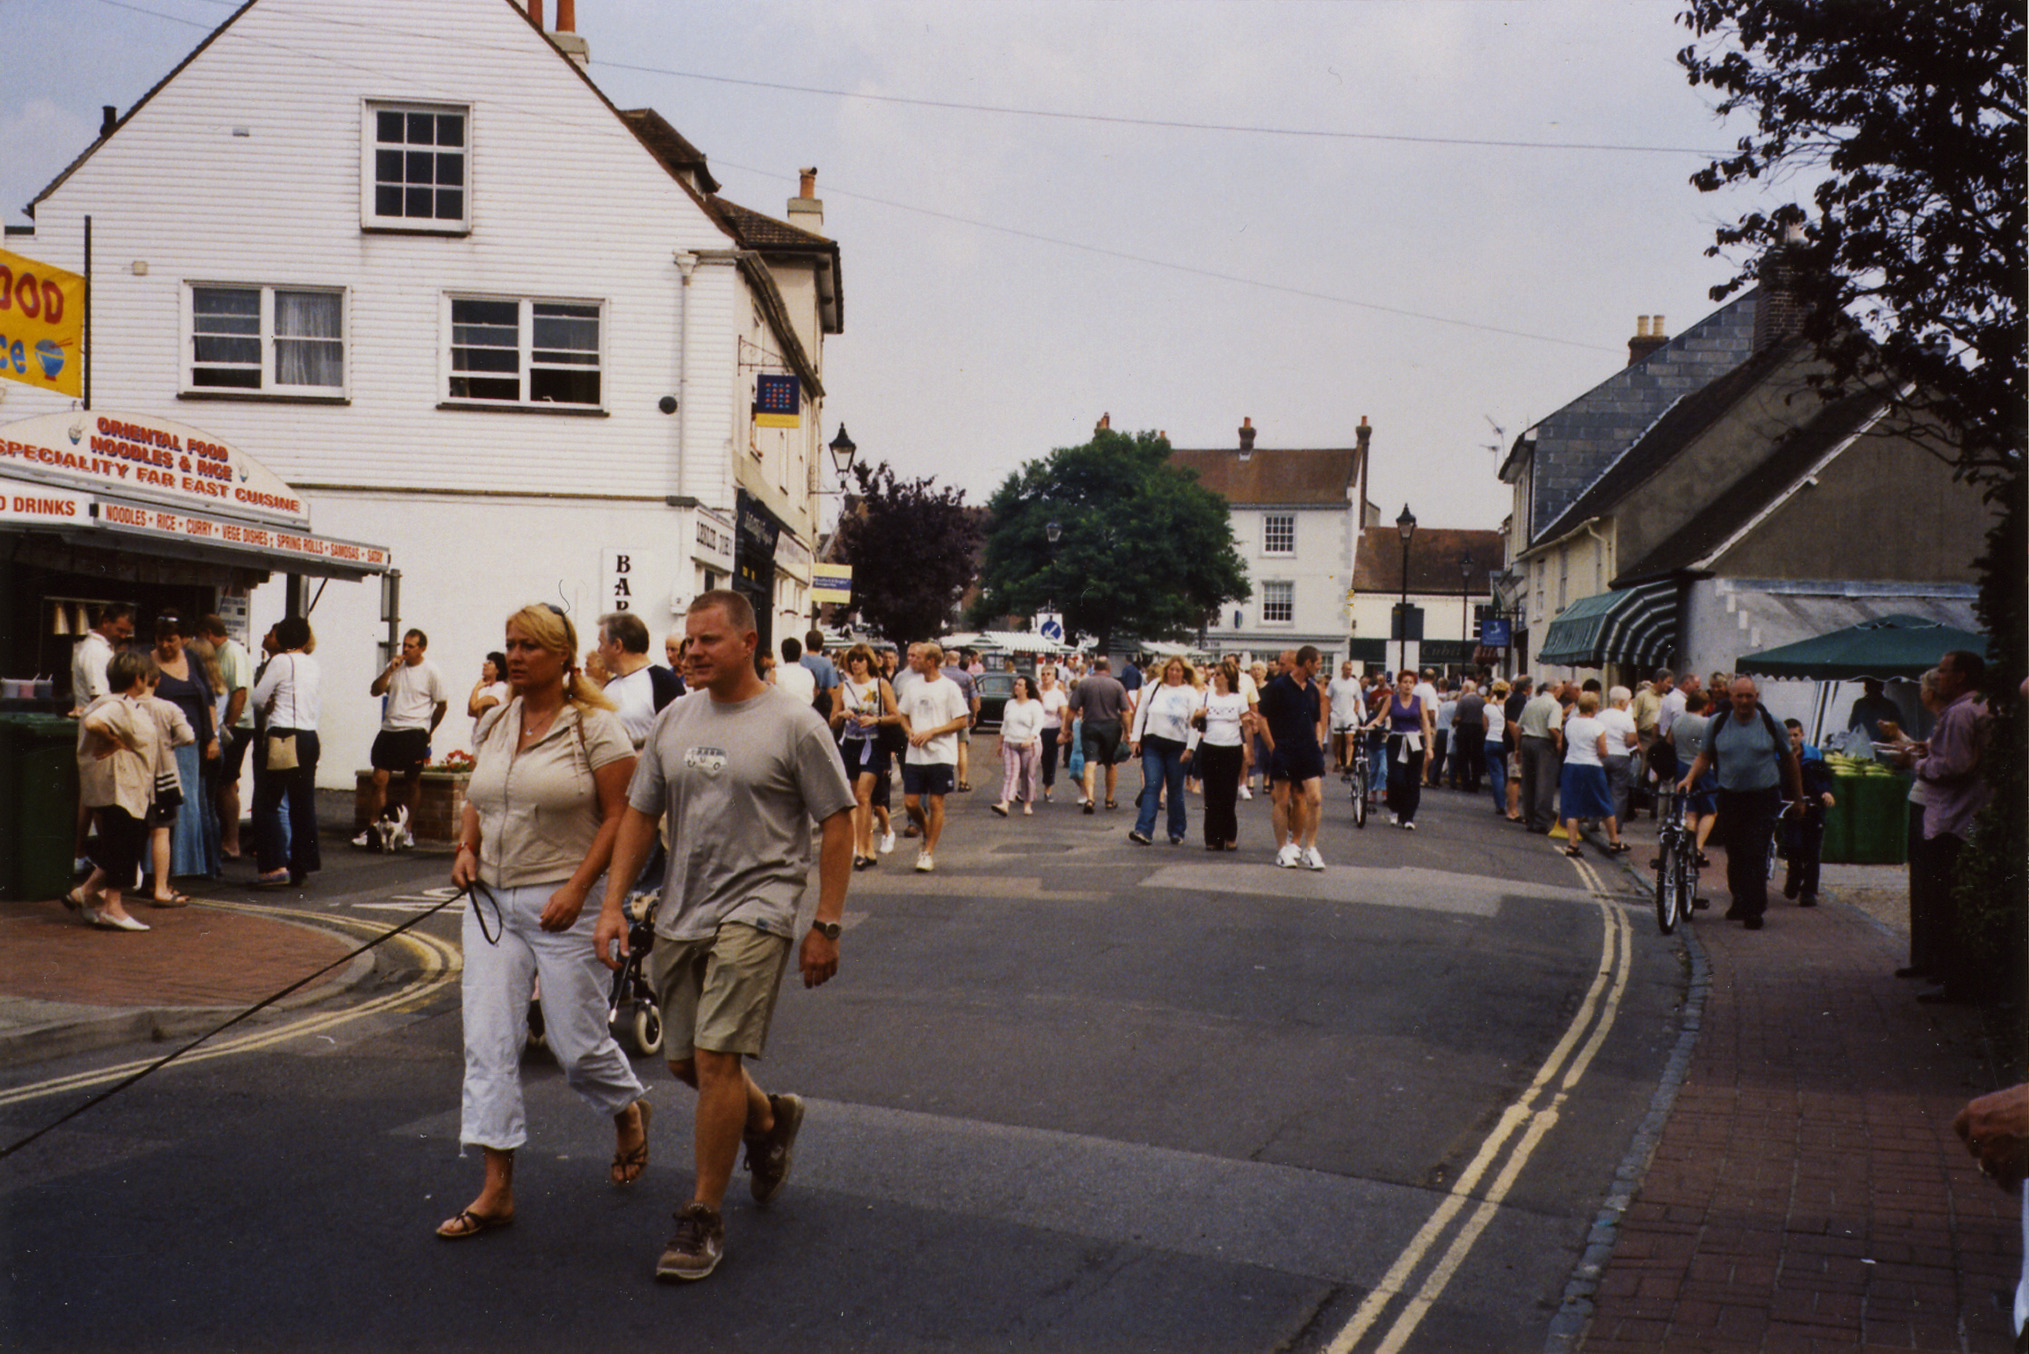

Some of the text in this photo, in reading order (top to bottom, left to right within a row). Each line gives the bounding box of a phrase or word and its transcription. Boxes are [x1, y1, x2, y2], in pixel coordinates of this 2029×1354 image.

[90, 435, 232, 482] NOODLES & RICE
[97, 416, 228, 462] ORIENTAL FOOD
[13, 496, 76, 516] DRINKS
[137, 467, 176, 488] FAR
[182, 477, 229, 498] EAST
[235, 488, 300, 513] CUISINE
[106, 505, 146, 526] NOODLES
[156, 513, 176, 531] RICE
[186, 519, 212, 536] CURRY
[222, 525, 241, 541] VEGE
[243, 528, 268, 546] DISHES
[277, 534, 301, 551] SPRING
[303, 538, 323, 554] ROLLS
[331, 543, 359, 560] SAMOSAS
